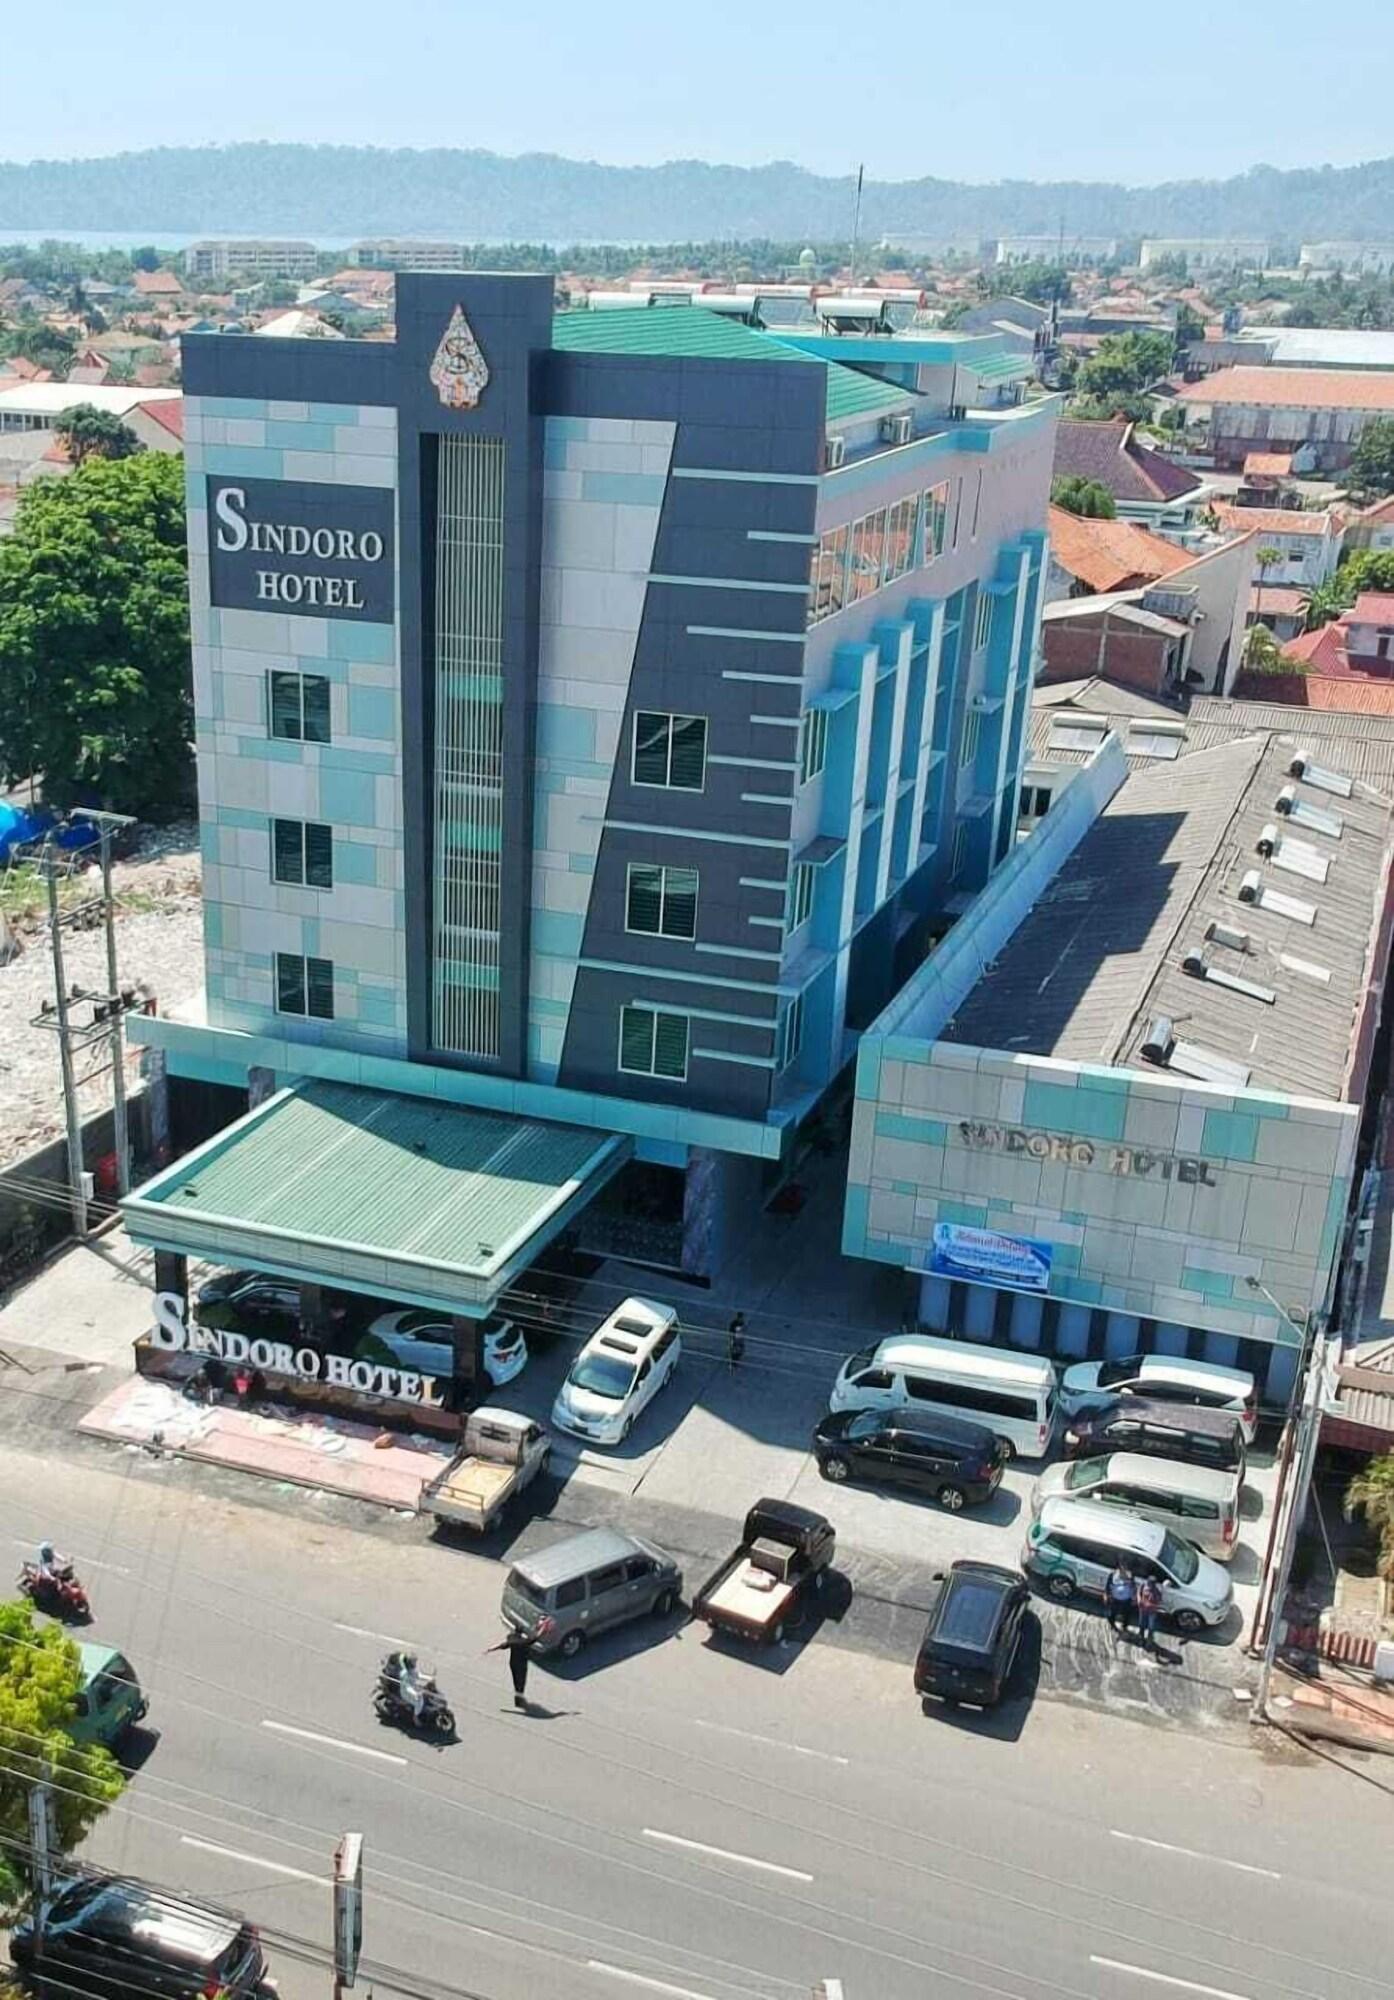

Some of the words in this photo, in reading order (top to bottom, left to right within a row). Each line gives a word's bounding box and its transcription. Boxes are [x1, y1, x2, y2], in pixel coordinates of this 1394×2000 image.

[215, 487, 384, 561] SINDORO
[257, 570, 365, 609] HOTEL
[151, 1292, 321, 1378] SINDORO
[325, 1353, 446, 1408] HOTEL
